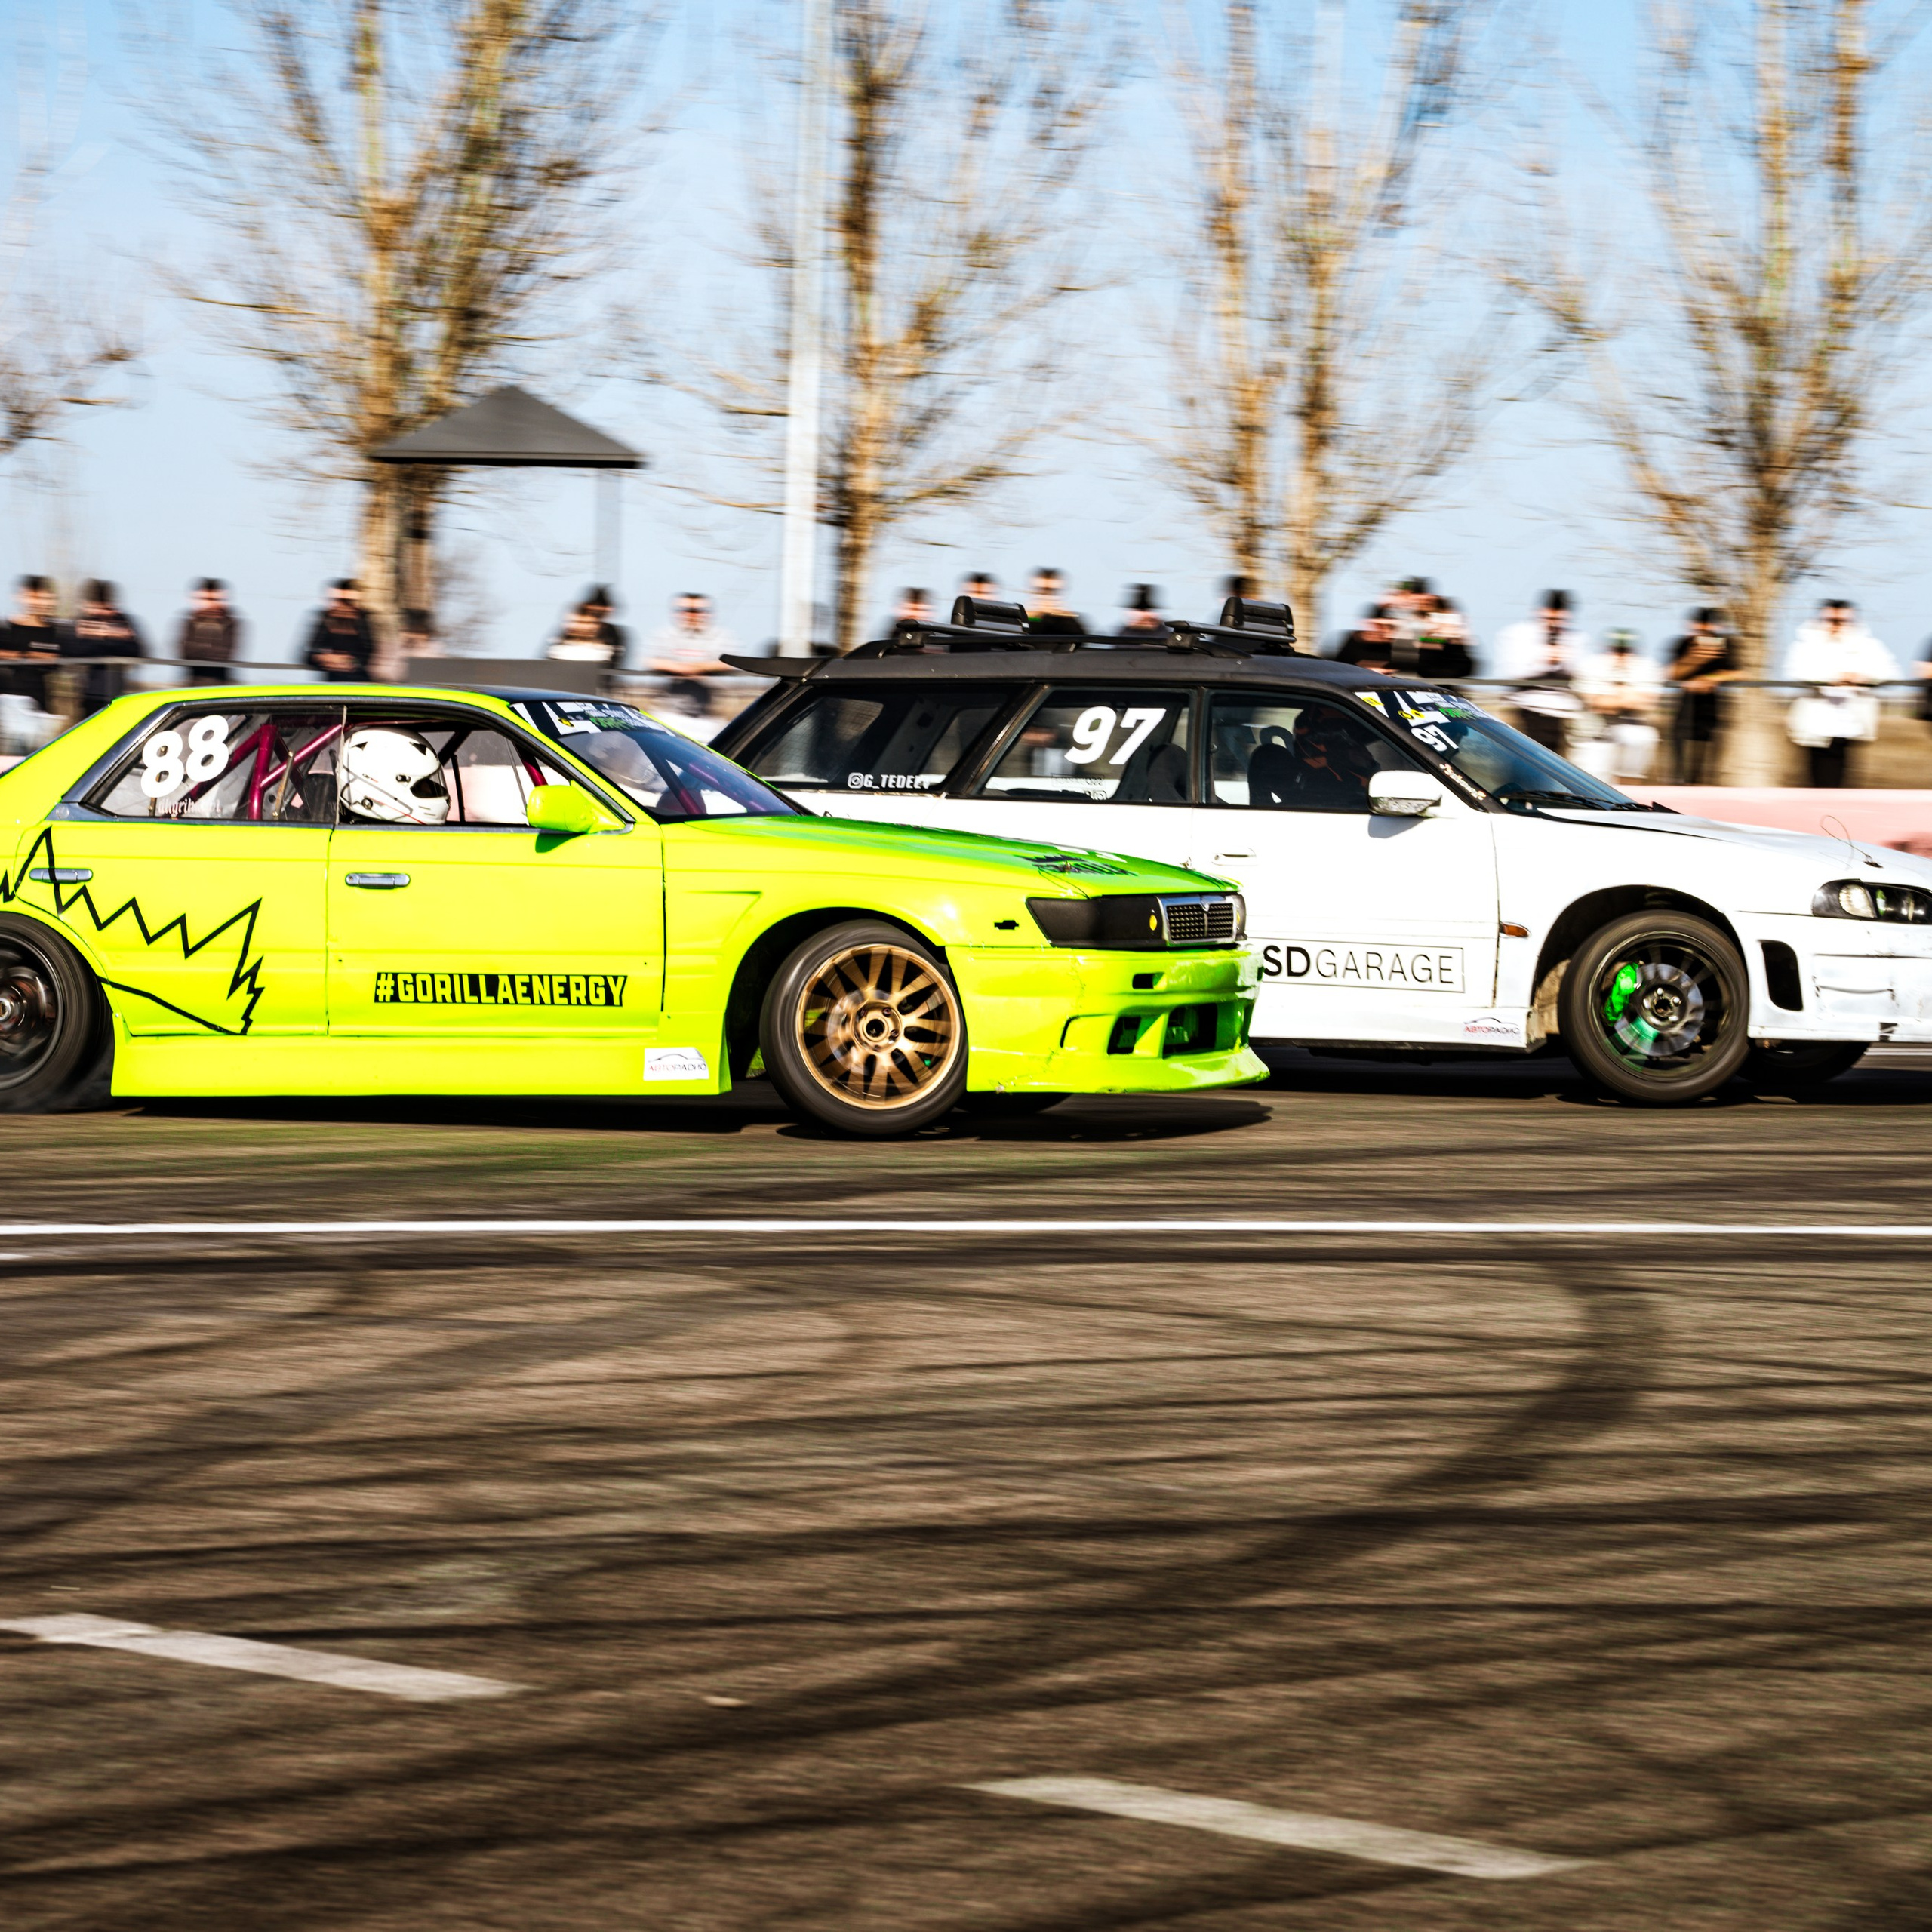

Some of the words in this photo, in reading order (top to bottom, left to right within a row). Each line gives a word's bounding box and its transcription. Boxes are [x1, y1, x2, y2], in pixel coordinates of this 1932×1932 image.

[140, 715, 229, 798] 88
[1064, 705, 1166, 765] 97
[1411, 724, 1459, 752] 97
[377, 973, 625, 1006] #GORILLAENERGY
